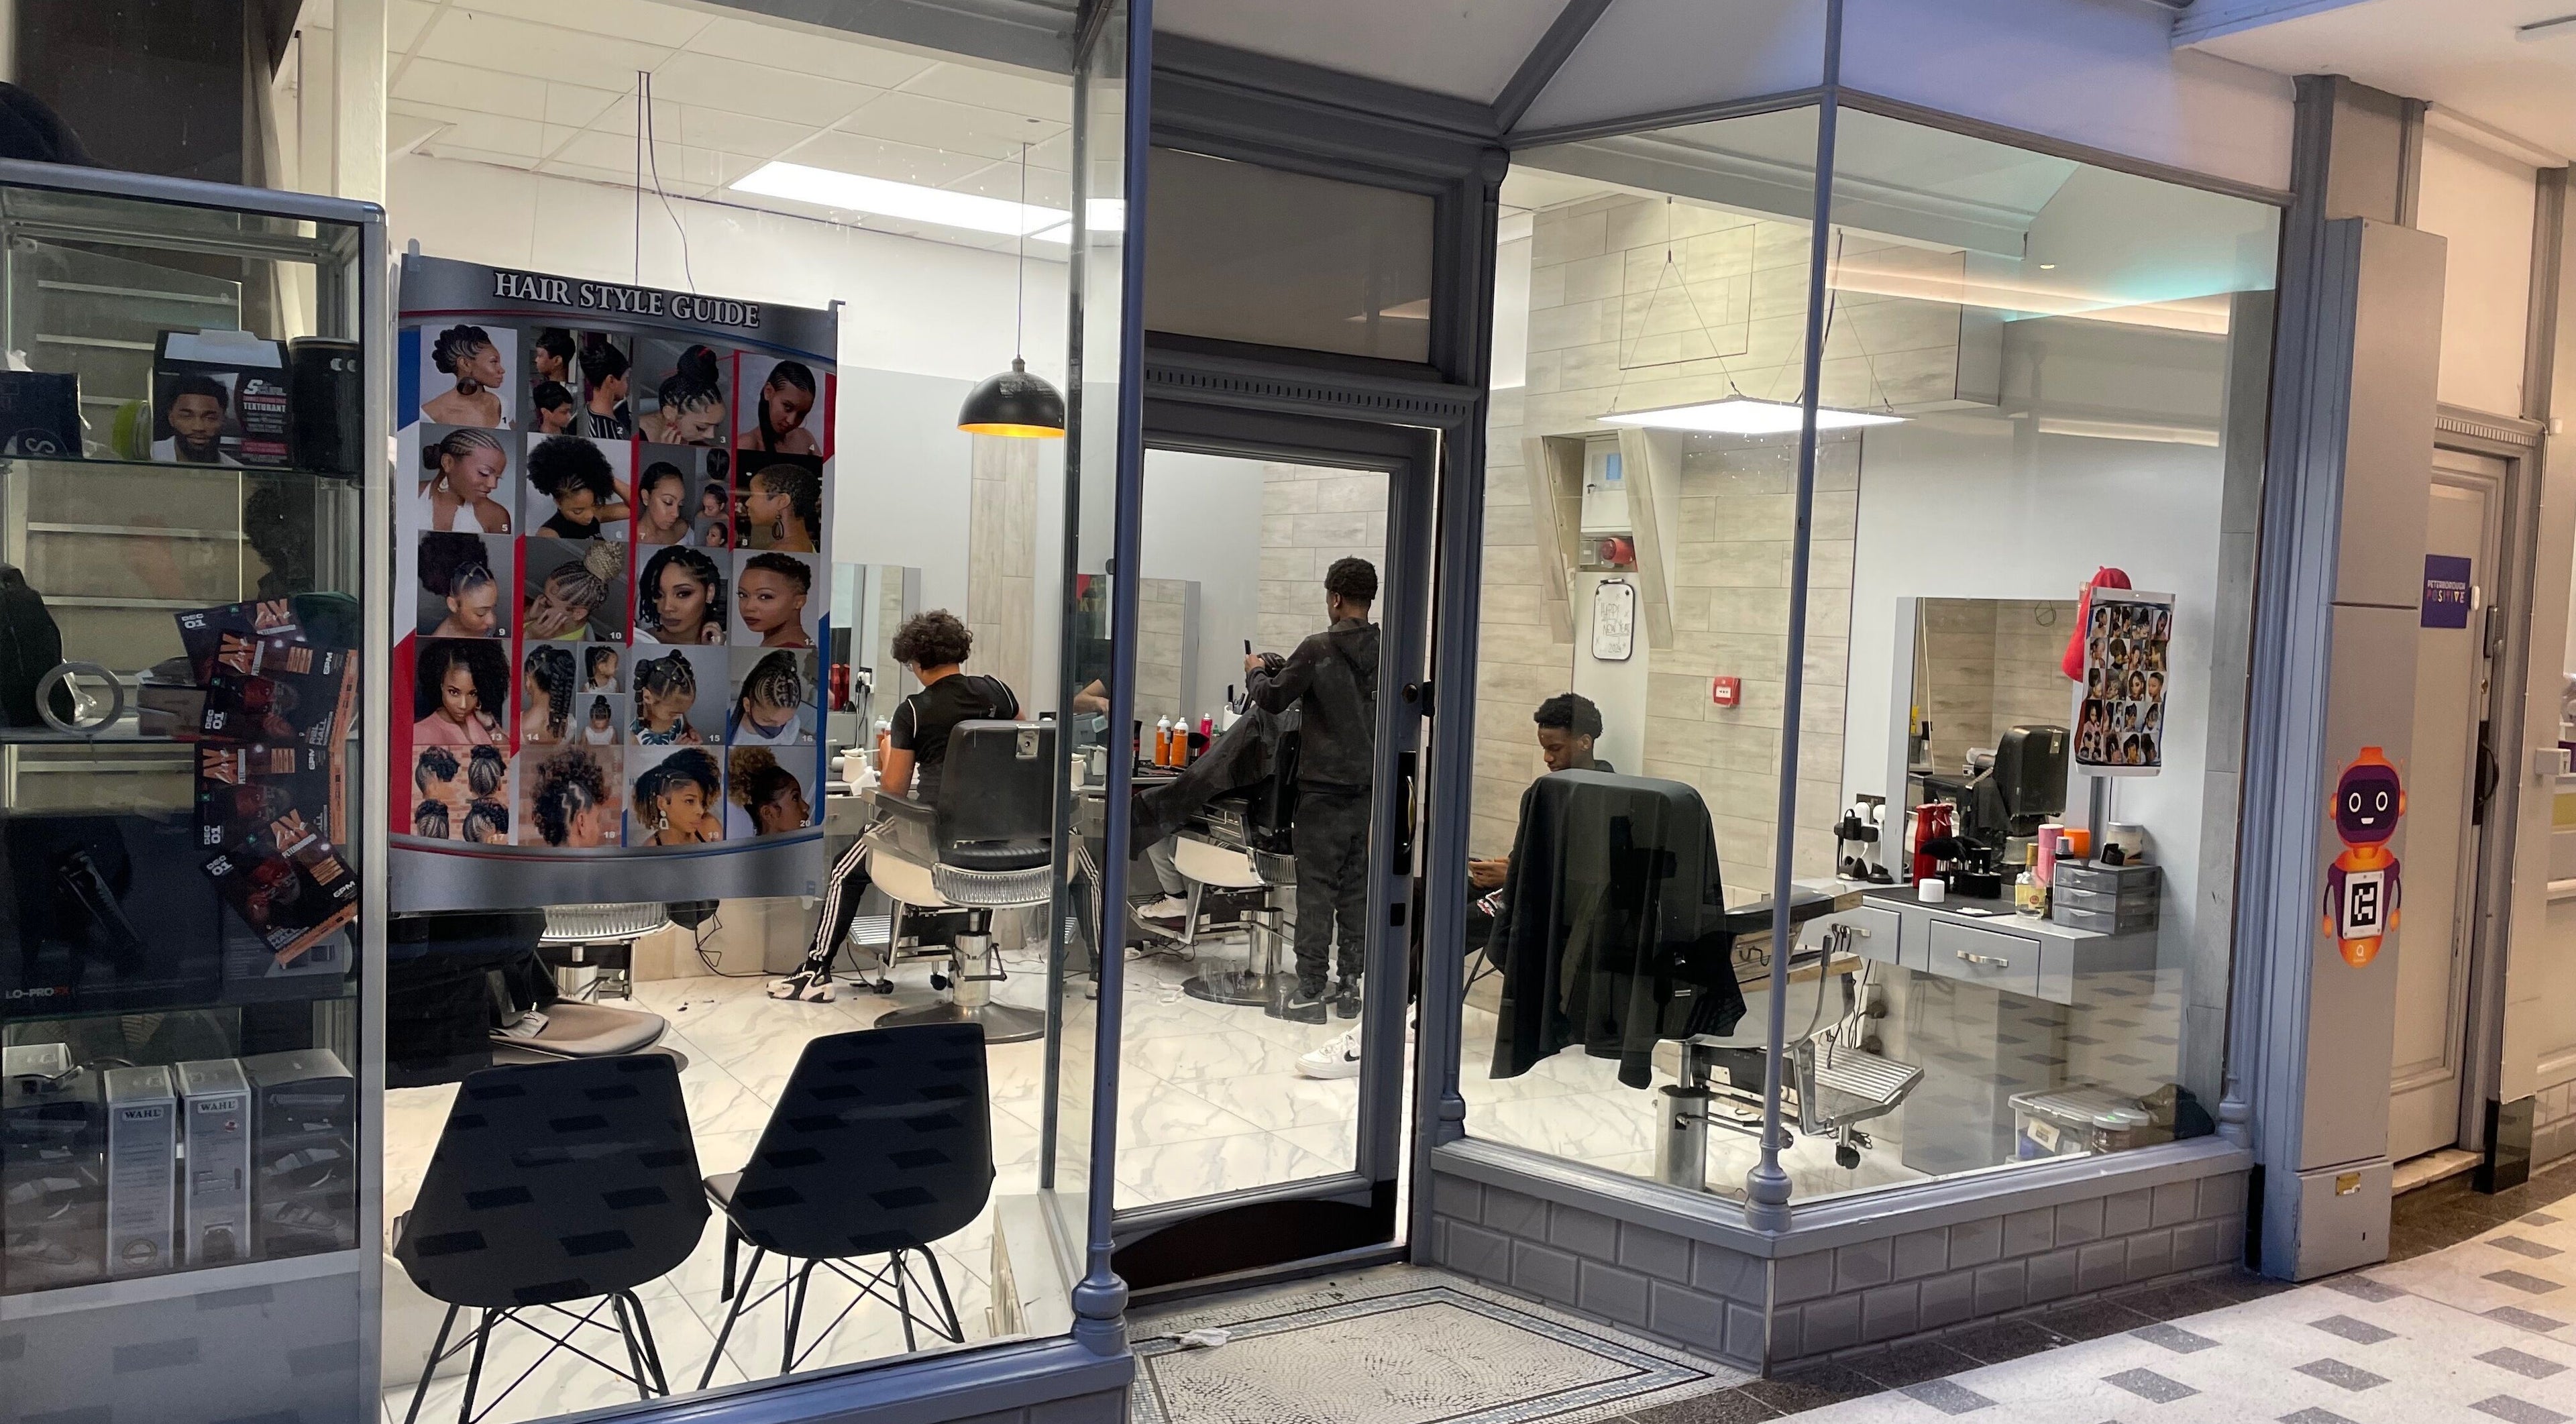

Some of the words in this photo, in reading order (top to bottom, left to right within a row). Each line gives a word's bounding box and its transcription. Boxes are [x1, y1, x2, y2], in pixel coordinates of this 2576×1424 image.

[494, 272, 572, 305] HAIR
[580, 283, 663, 315] STYLE
[672, 295, 759, 327] GUIDE
[616, 427, 623, 435] 2
[502, 524, 508, 532] 5
[616, 531, 623, 539] 6
[2426, 589, 2465, 604] POSITIVE
[610, 632, 622, 640] 10
[804, 638, 815, 646] 12
[491, 733, 502, 741] 13
[527, 733, 539, 741] 14
[494, 833, 504, 841] 17
[201, 1101, 235, 1111] WAHL
[125, 1109, 161, 1119] WAHL
